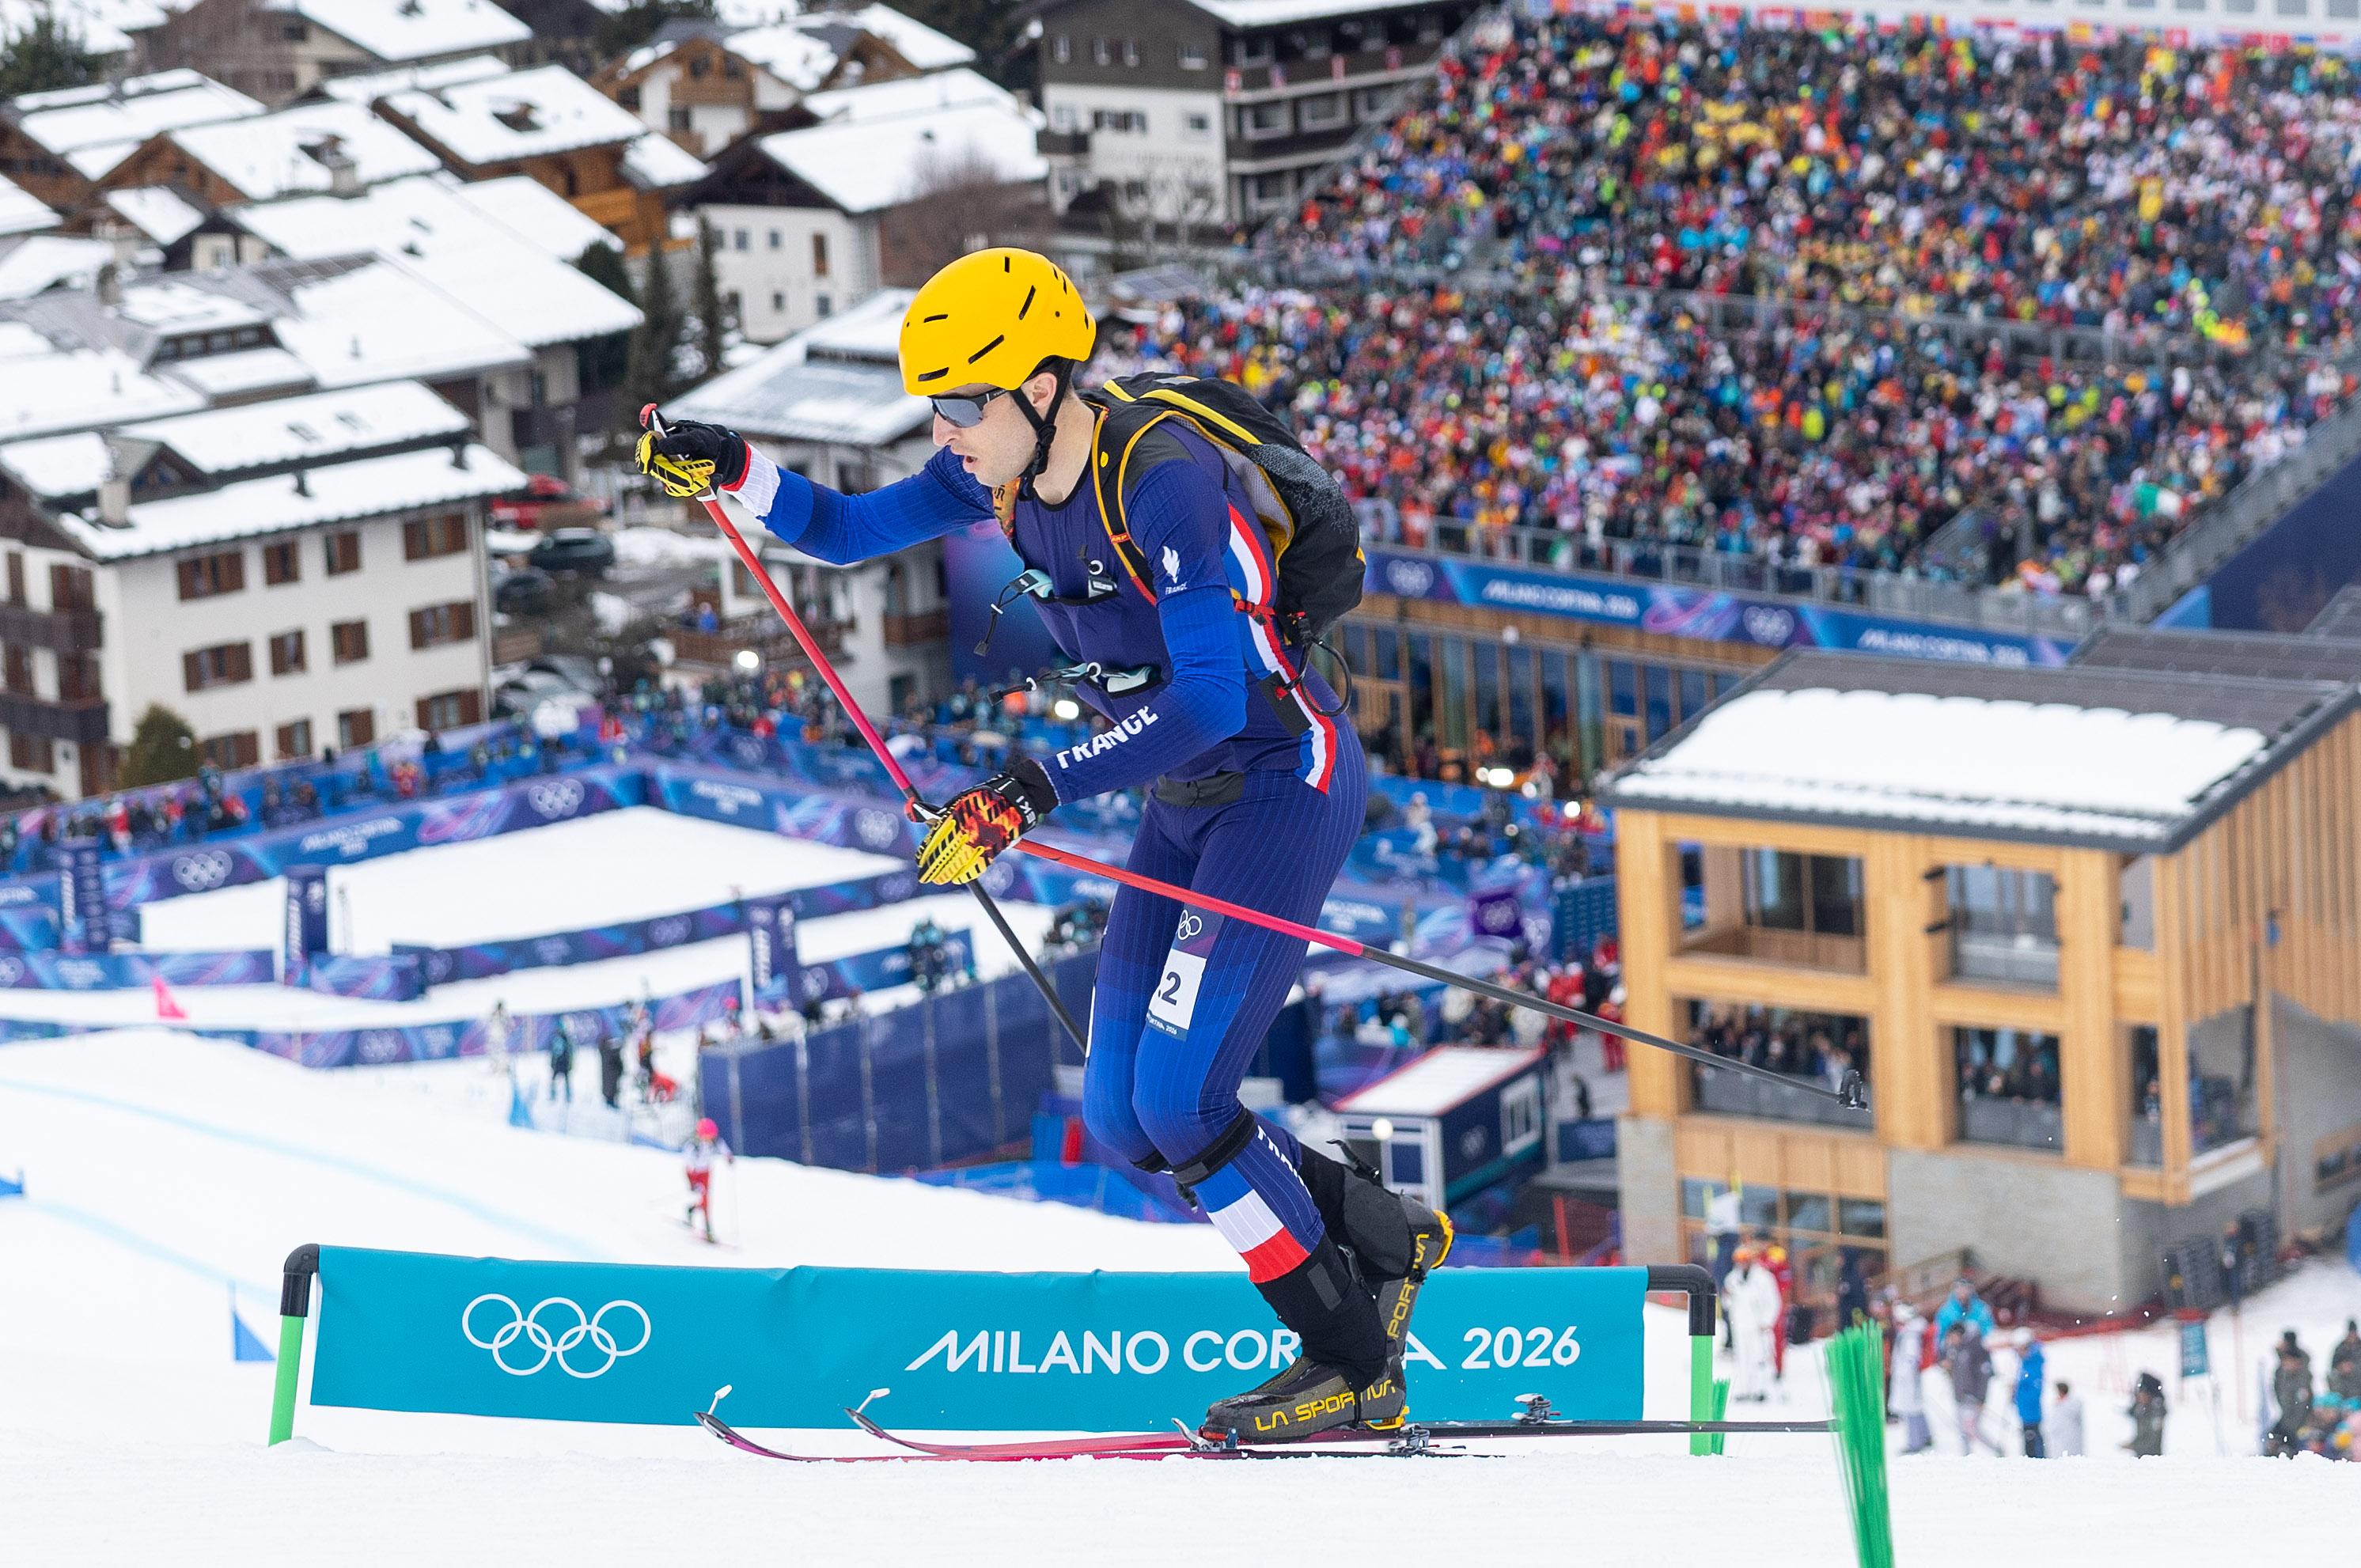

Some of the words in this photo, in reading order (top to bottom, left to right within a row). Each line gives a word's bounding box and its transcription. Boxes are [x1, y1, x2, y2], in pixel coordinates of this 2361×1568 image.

[1056, 705, 1159, 769] FRANCE
[905, 1330, 1169, 1374] MILANO
[1183, 1328, 1448, 1372] CORA
[1461, 1326, 1581, 1369] 2026
[1254, 1411, 1289, 1431] LA
